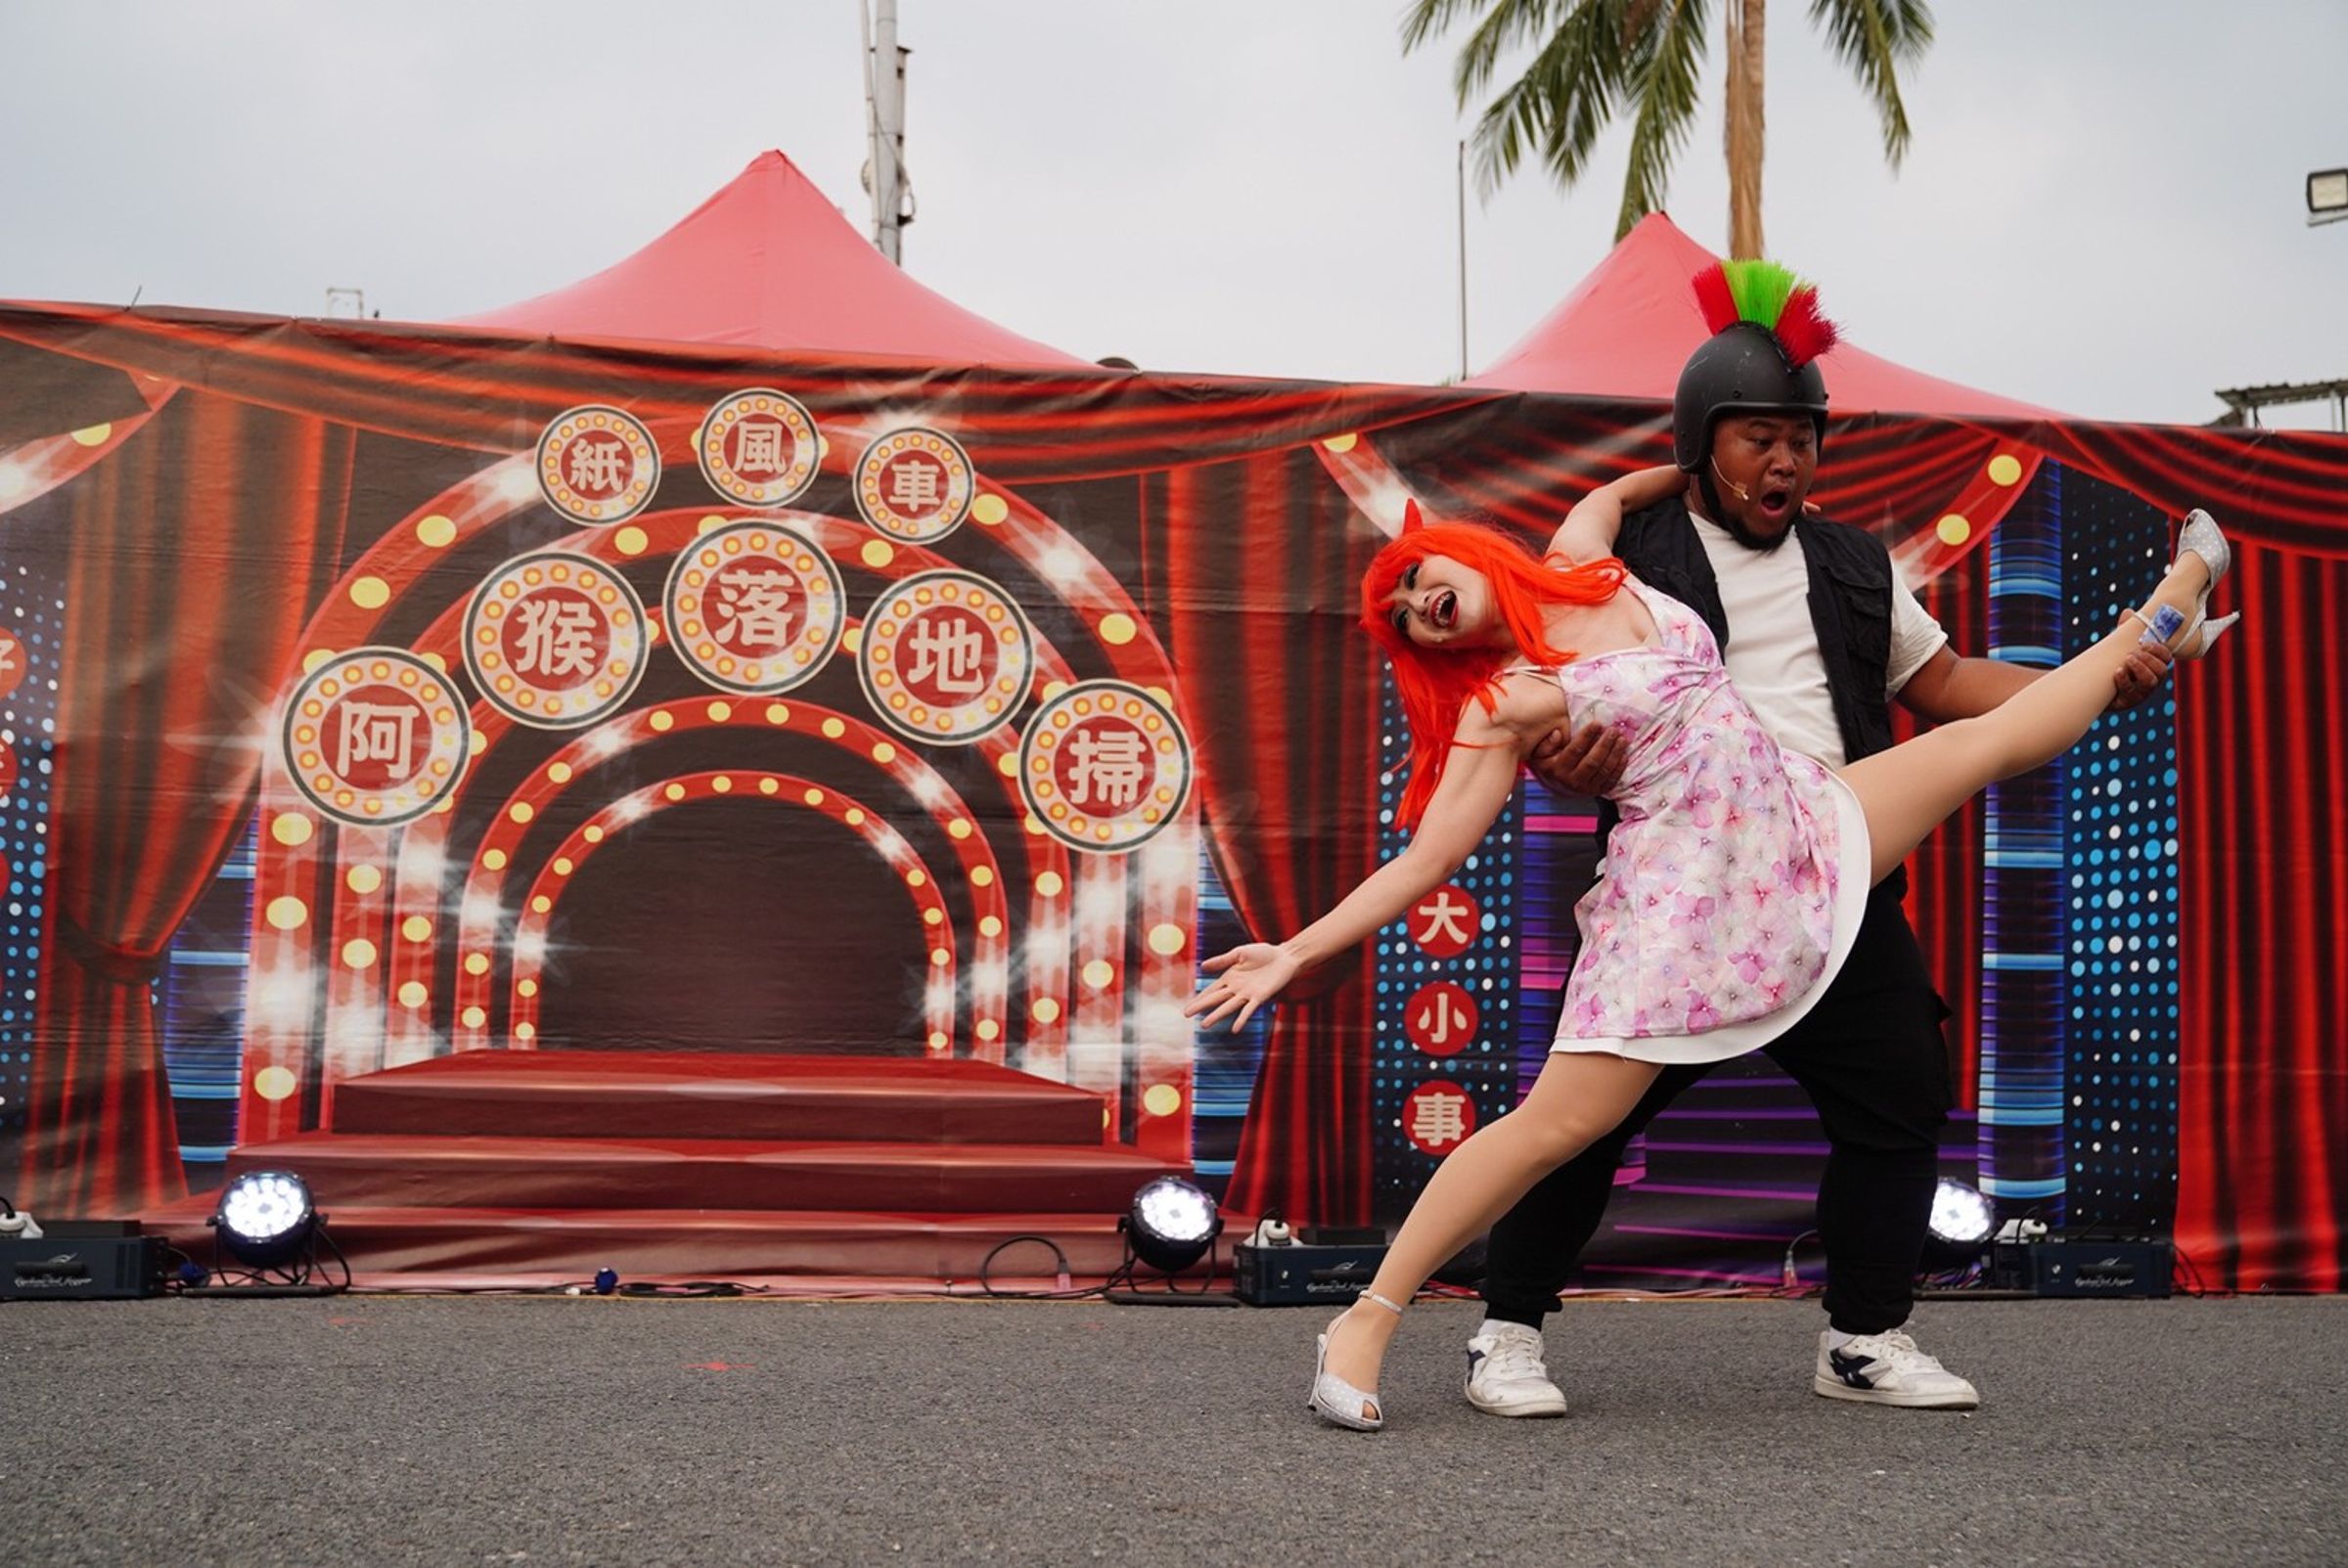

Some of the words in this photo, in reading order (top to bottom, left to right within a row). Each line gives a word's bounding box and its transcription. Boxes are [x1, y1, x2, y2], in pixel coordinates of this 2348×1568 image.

[568, 421, 941, 513] 紙風車
[337, 569, 1148, 808] 阿猴落地掃
[1412, 892, 1468, 1145] 大小事
